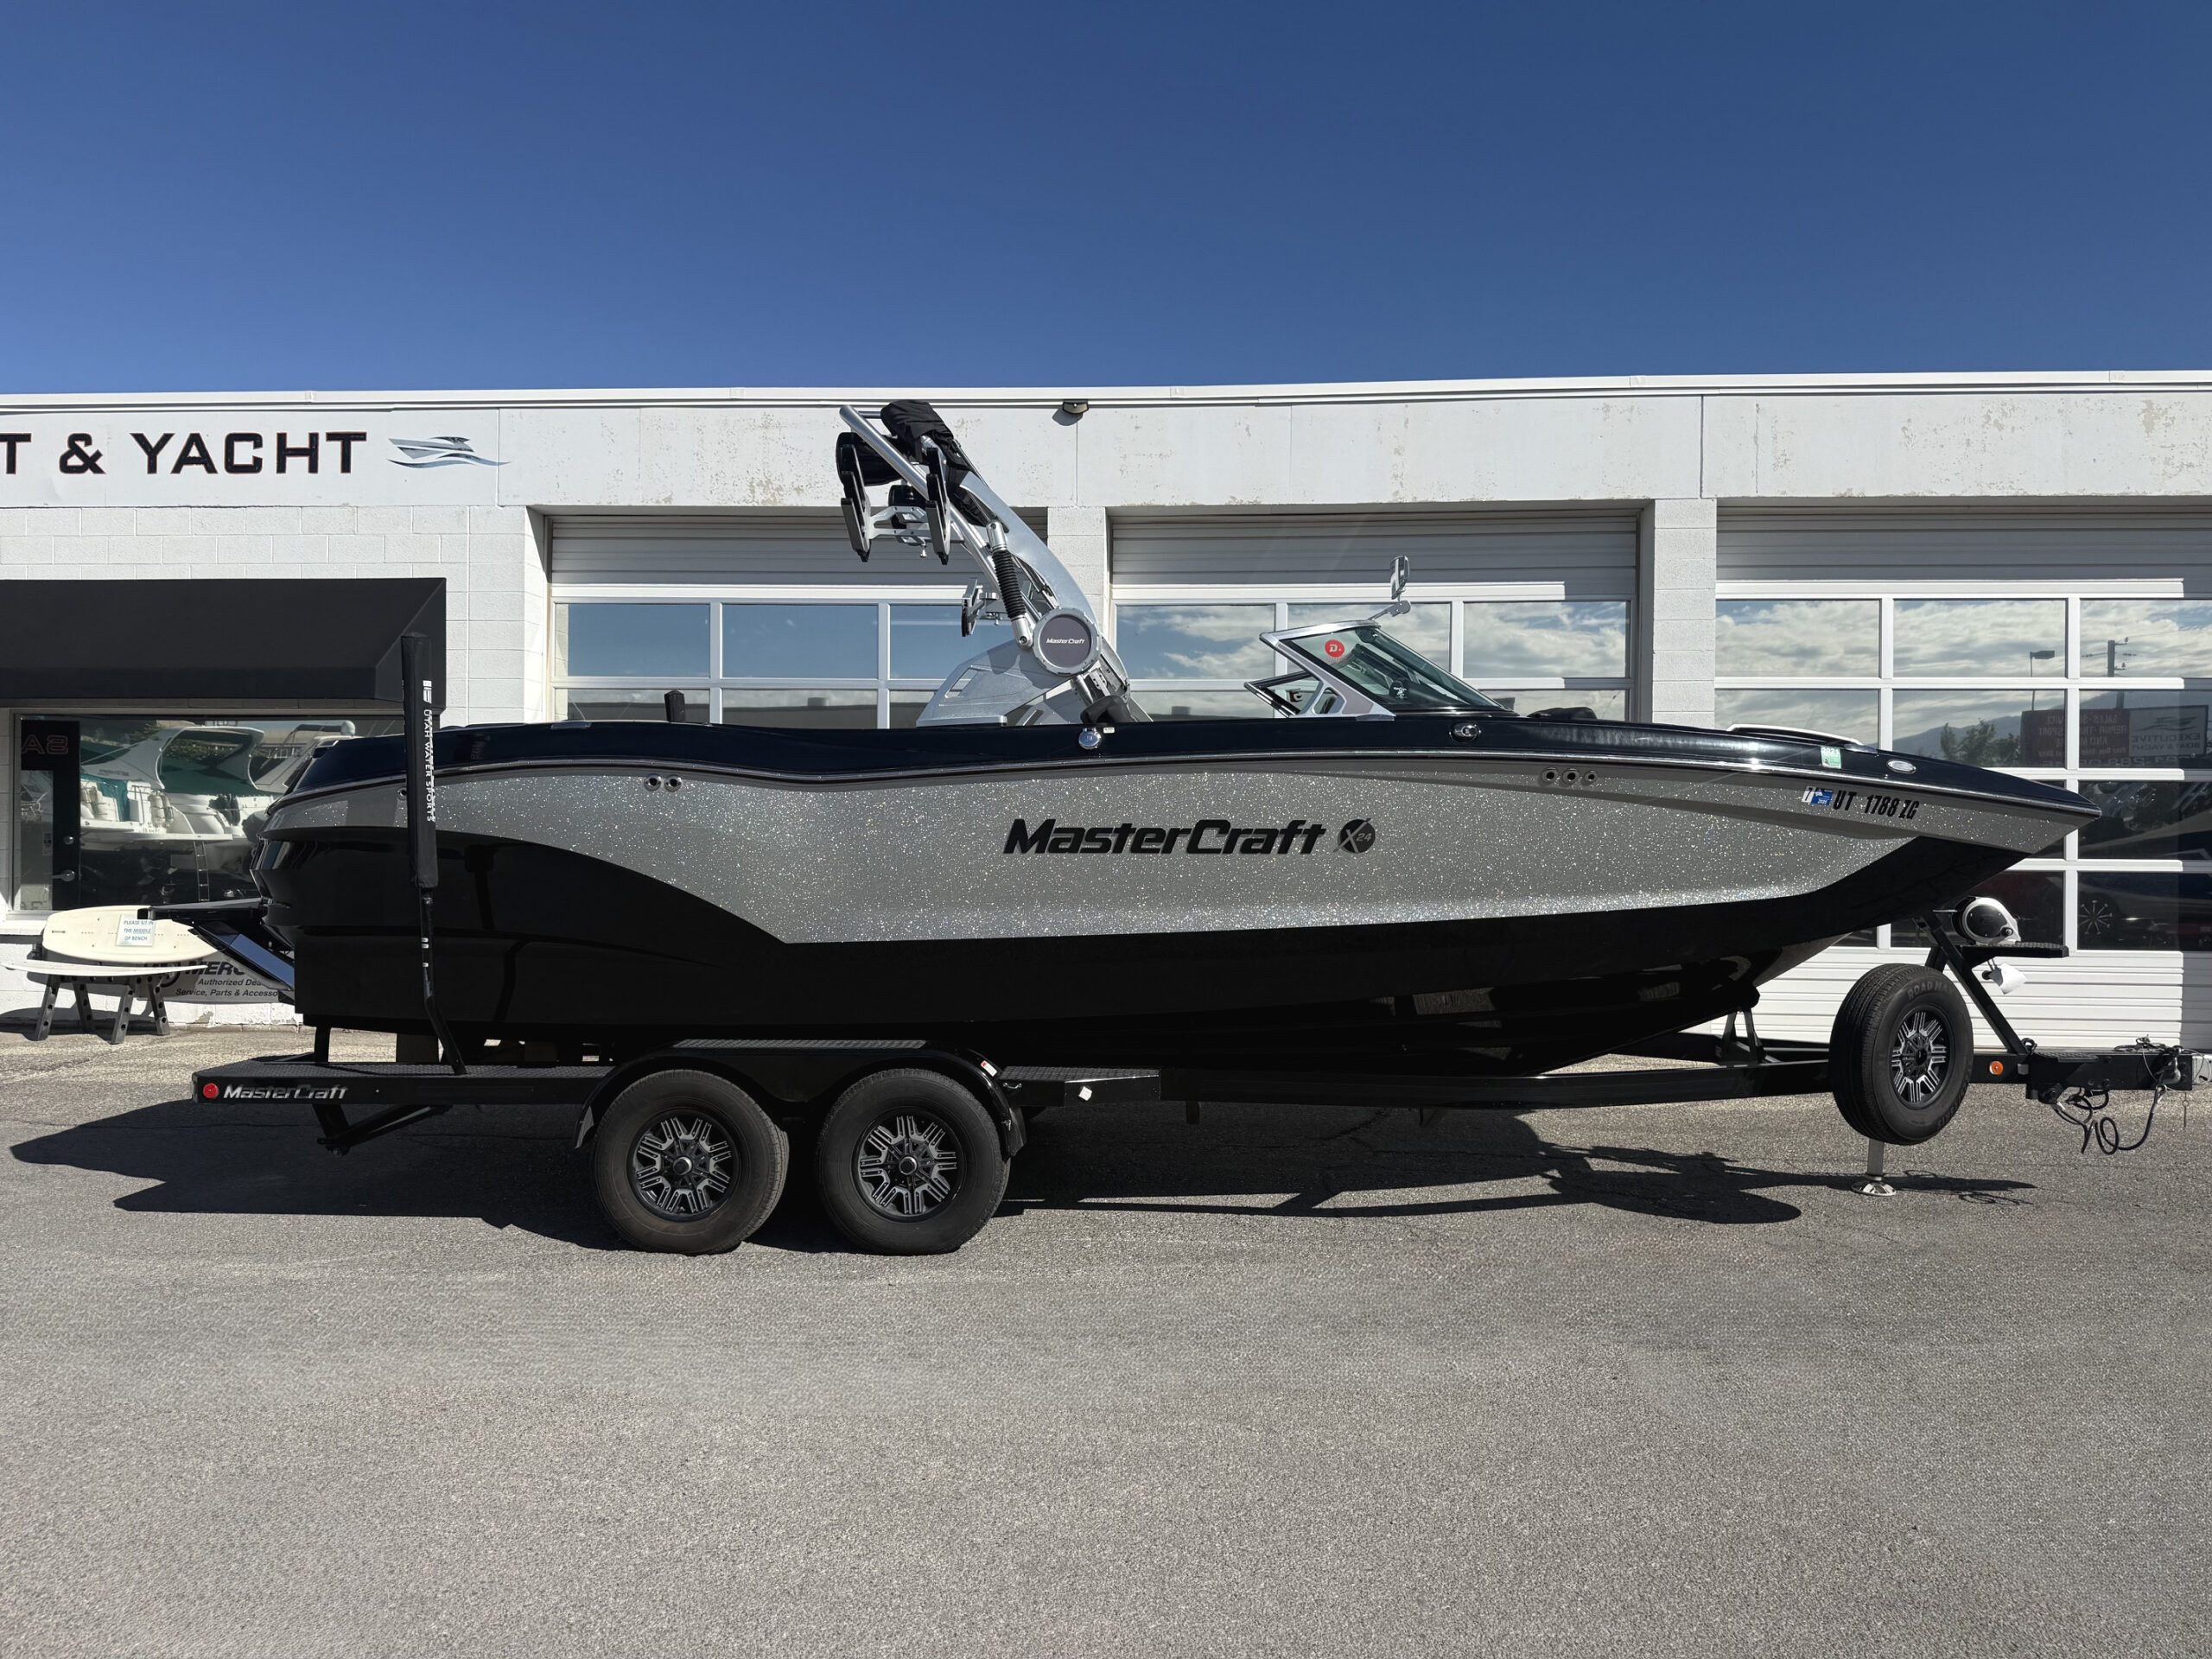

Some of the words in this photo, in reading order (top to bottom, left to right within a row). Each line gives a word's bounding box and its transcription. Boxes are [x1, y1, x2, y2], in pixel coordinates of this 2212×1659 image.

[0, 432, 32, 474] T
[58, 432, 106, 474] &
[130, 432, 367, 474] YACHT
[423, 709, 433, 738] UTAH
[424, 741, 434, 778] WATER
[426, 780, 436, 823] SPORTS
[1834, 790, 1857, 810] UT
[1865, 795, 1900, 817] 1788
[1002, 818, 1326, 855] MasterCraft
[175, 988, 207, 996] Service,
[197, 977, 244, 986] Authorized
[223, 1084, 348, 1099] MasterCraft
